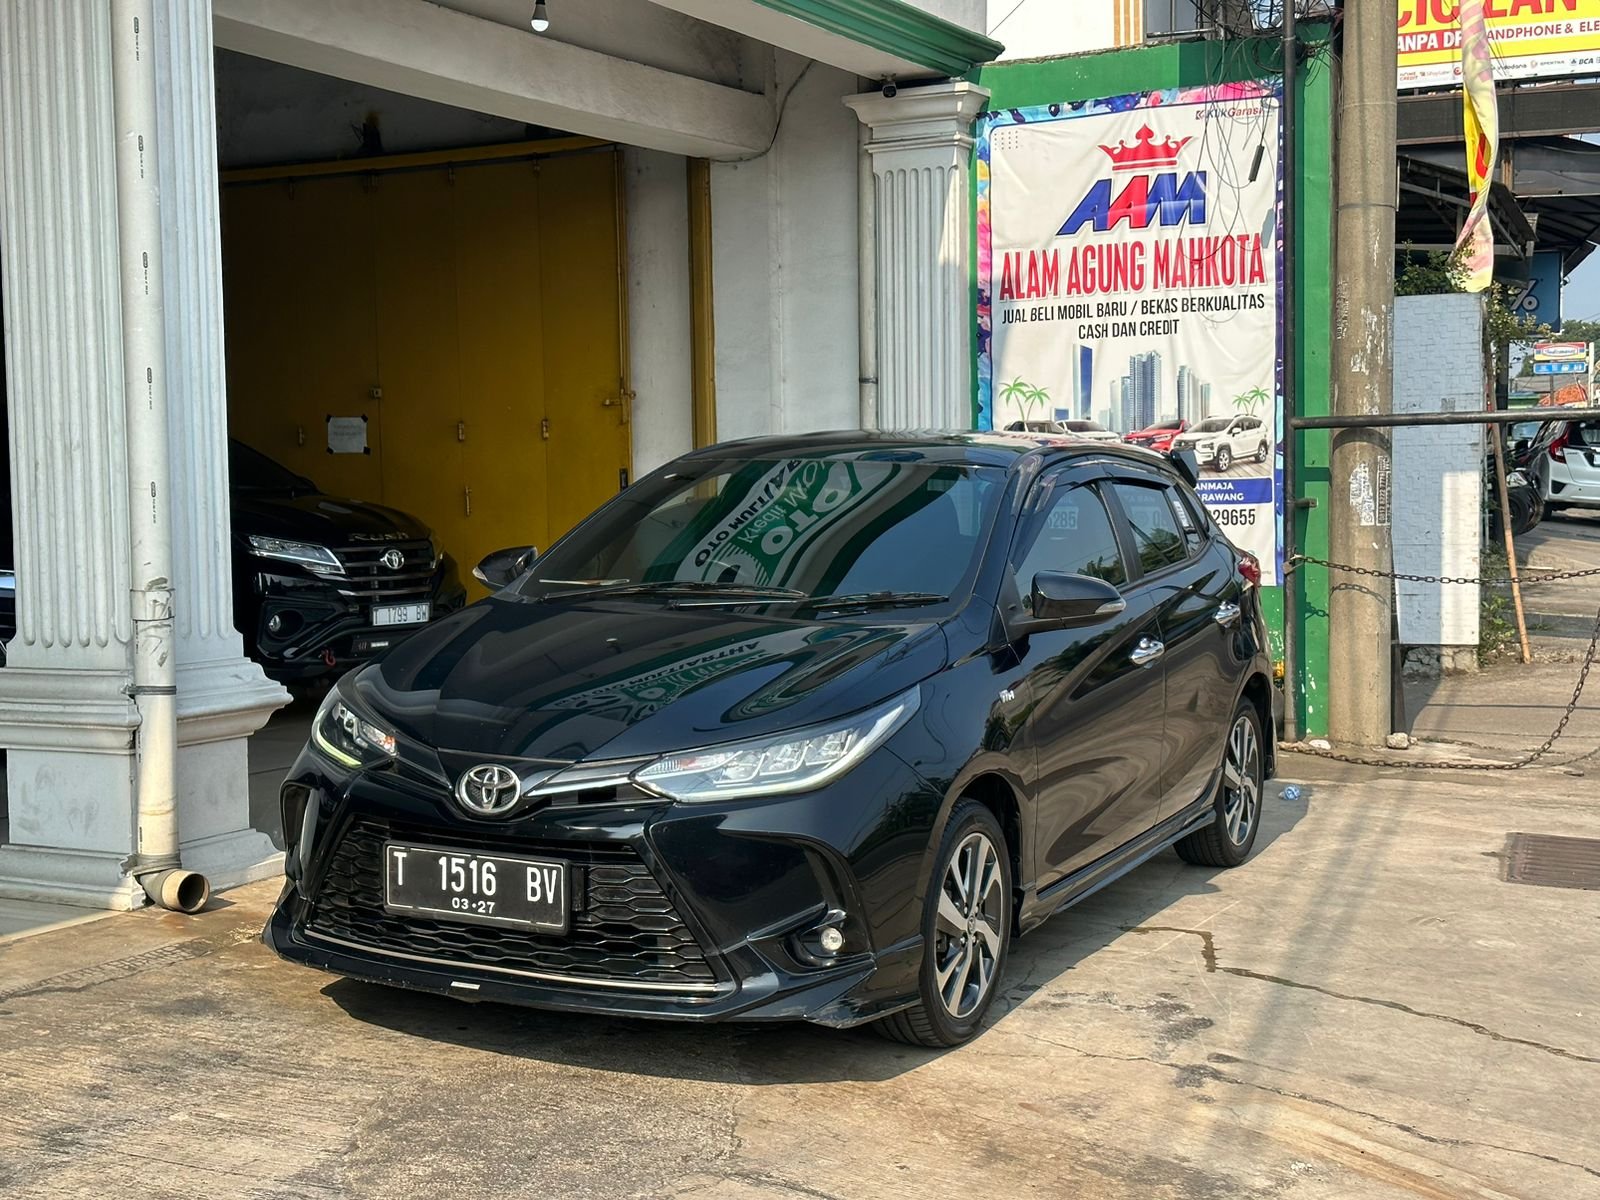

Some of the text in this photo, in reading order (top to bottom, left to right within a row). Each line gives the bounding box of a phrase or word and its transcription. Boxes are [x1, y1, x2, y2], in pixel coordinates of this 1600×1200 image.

[1564, 23, 1574, 34] &
[1055, 170, 1207, 236] AAM
[999, 232, 1265, 301] ALAM AGUNG MAHKOTA
[1002, 293, 1265, 324] JUAL BELI MOBIL BARU / BEKAS BERKUALITAS
[1078, 319, 1180, 340] CASH DAN CREDIT
[1209, 508, 1256, 526] 29655
[393, 851, 557, 905] T 1516 BV
